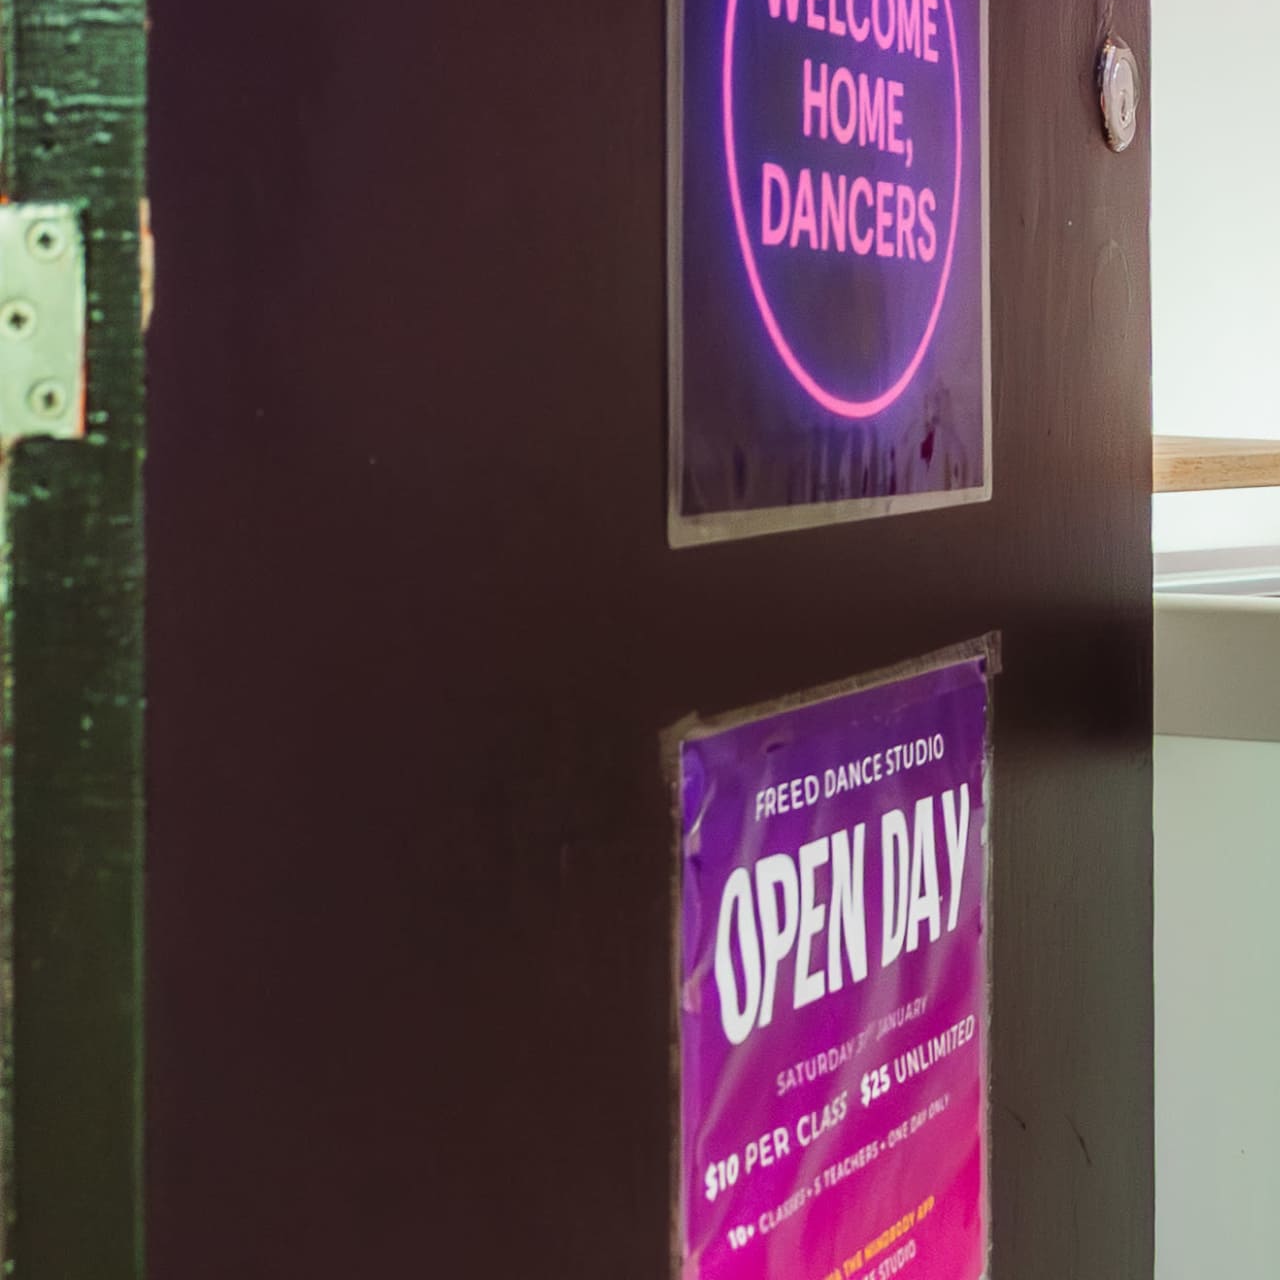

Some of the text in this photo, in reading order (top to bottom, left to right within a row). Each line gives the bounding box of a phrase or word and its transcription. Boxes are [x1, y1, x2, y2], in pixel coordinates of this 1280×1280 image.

[803, 58, 914, 167] HOME,
[762, 162, 937, 262] DANCERS
[756, 733, 944, 822] FREED DANCE STUDIO
[715, 782, 970, 1045] OPEN DAY
[776, 1037, 855, 1096] SATURDAY
[876, 994, 928, 1041] JANUARY
[705, 1014, 975, 1202] $10 PER CLASS $25 UNLIMITED
[823, 1140, 879, 1187] TEACHERS
